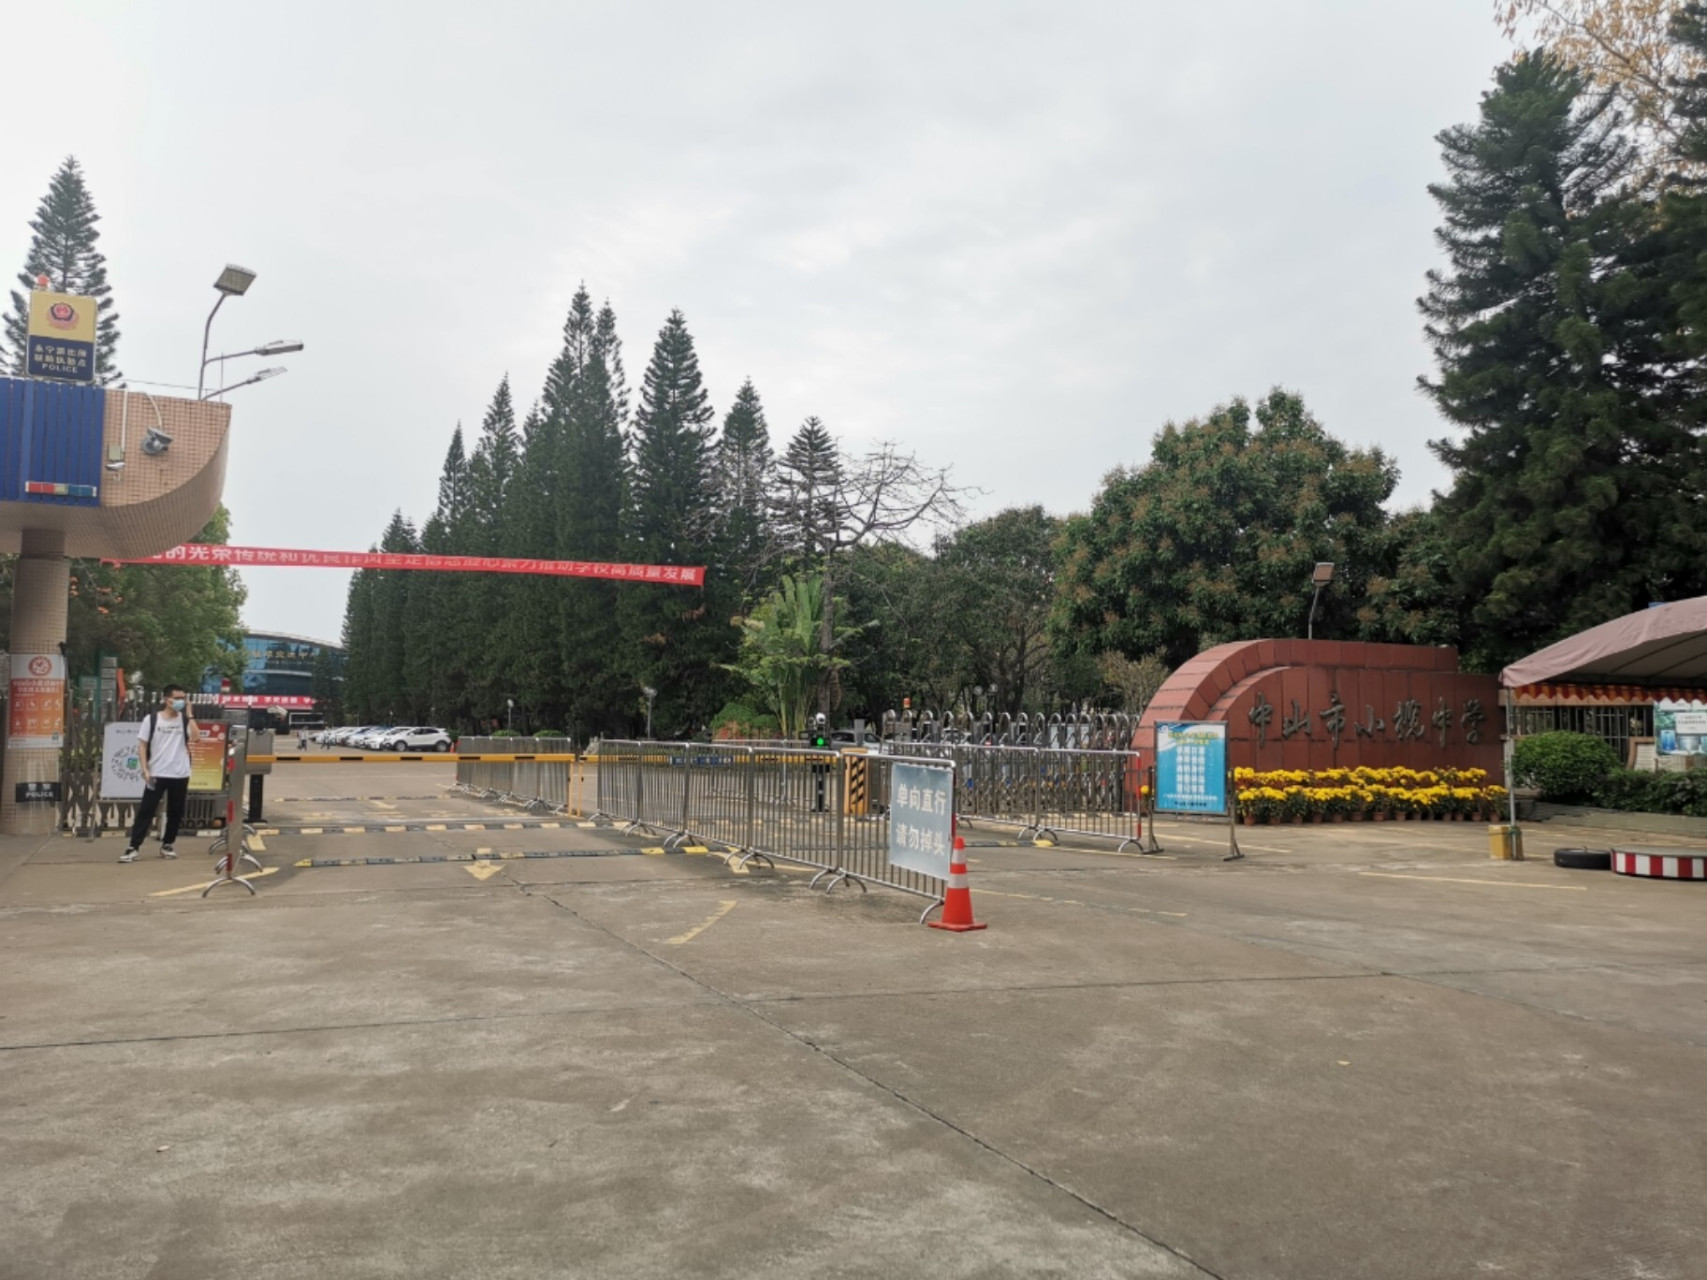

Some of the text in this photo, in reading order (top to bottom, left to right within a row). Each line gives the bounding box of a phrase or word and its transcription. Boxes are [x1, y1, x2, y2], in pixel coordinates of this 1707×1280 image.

[42, 363, 78, 374] POLICE
[152, 545, 697, 581] 的光荣传统和优良作风坚定信念凝心聚力推动学校高质量发展
[1248, 691, 1485, 750] 中山市小榄中学
[896, 783, 947, 816] 单向直行
[895, 822, 945, 856] 请勿掉头
